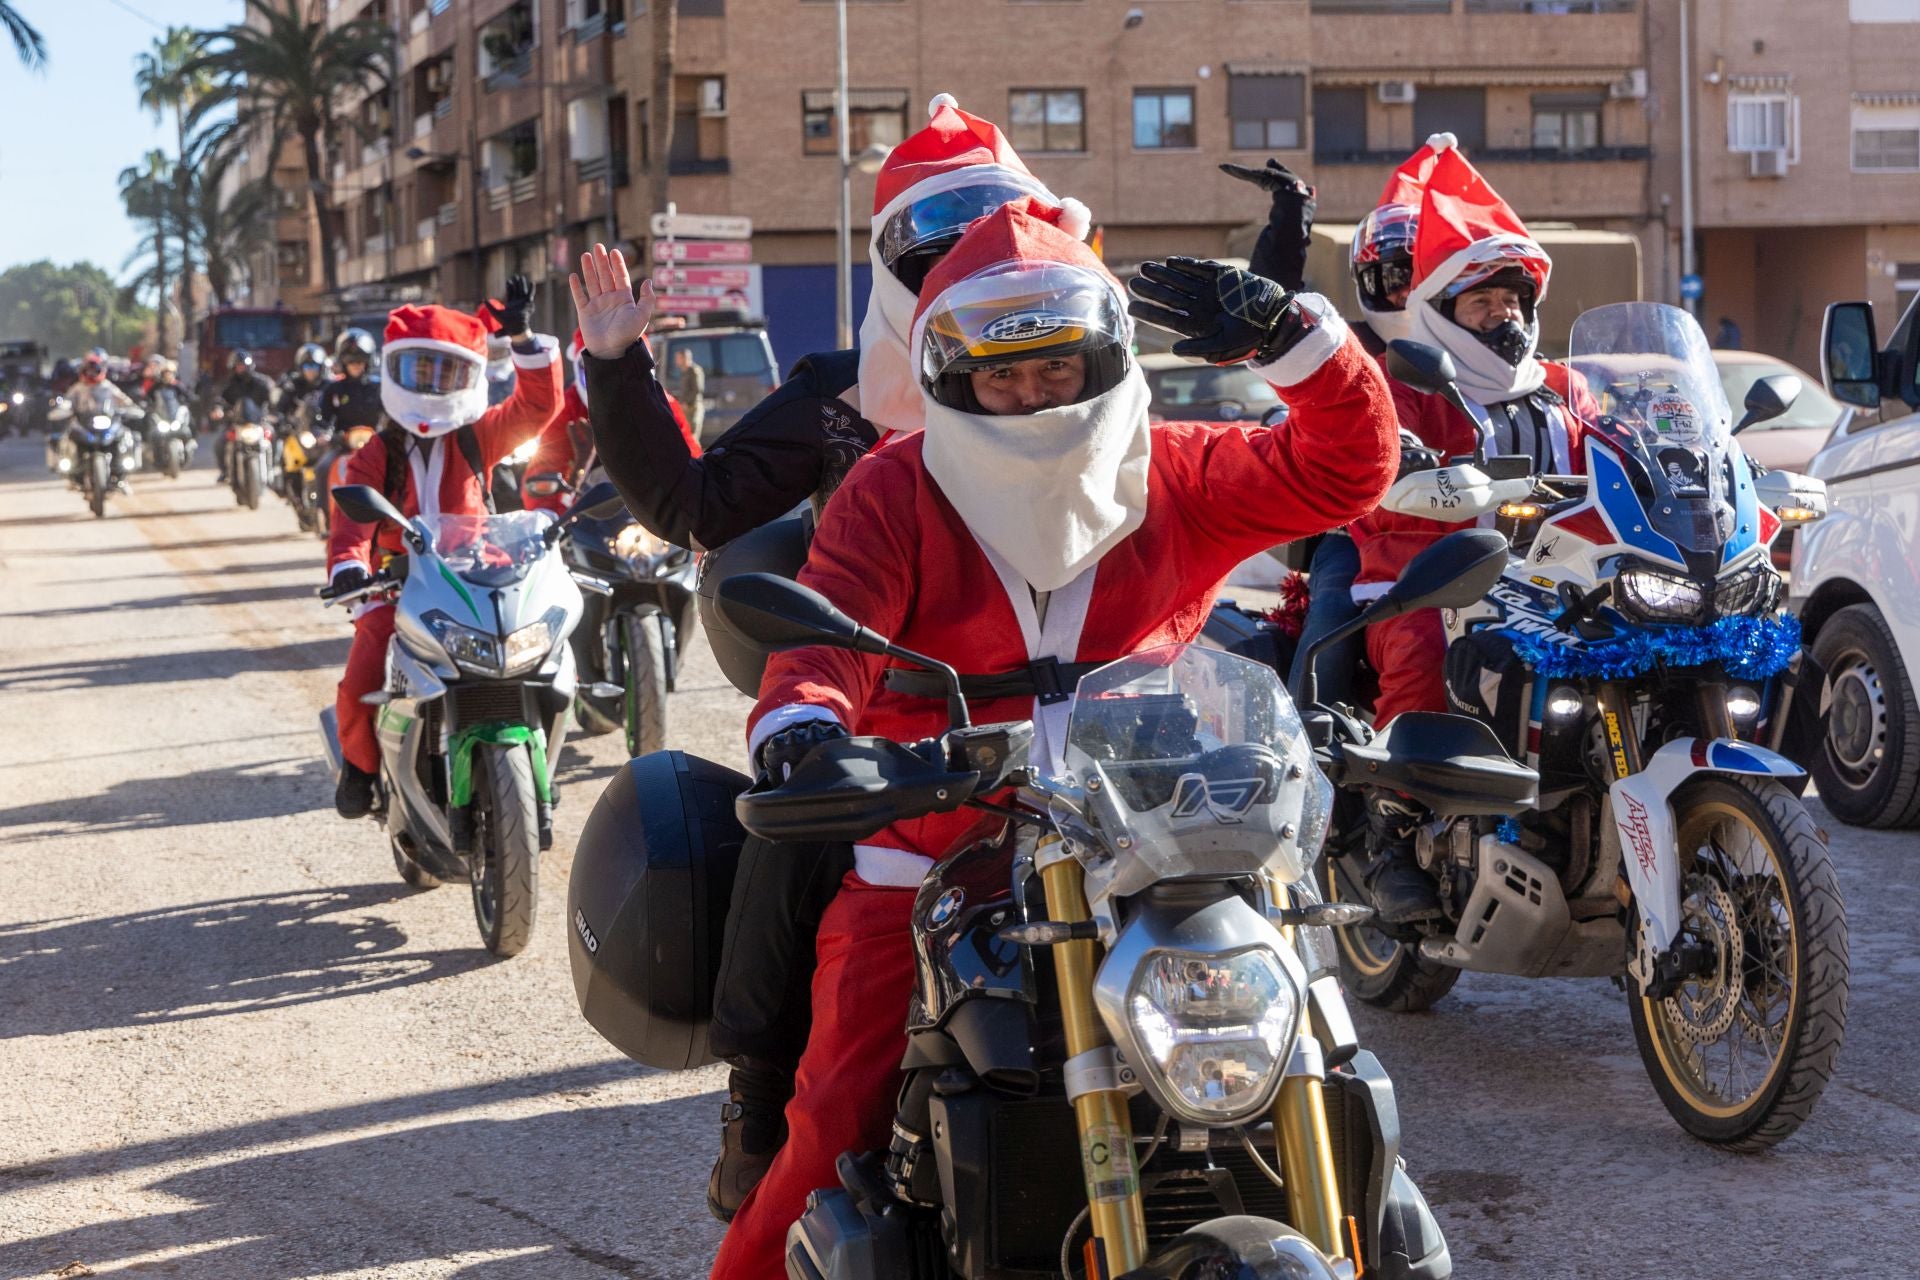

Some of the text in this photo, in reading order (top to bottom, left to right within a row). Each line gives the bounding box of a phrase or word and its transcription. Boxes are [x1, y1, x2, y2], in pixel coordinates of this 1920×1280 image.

[1605, 711, 1623, 748] RACE
[575, 909, 597, 952] SHAD
[1090, 1142, 1109, 1165] C
